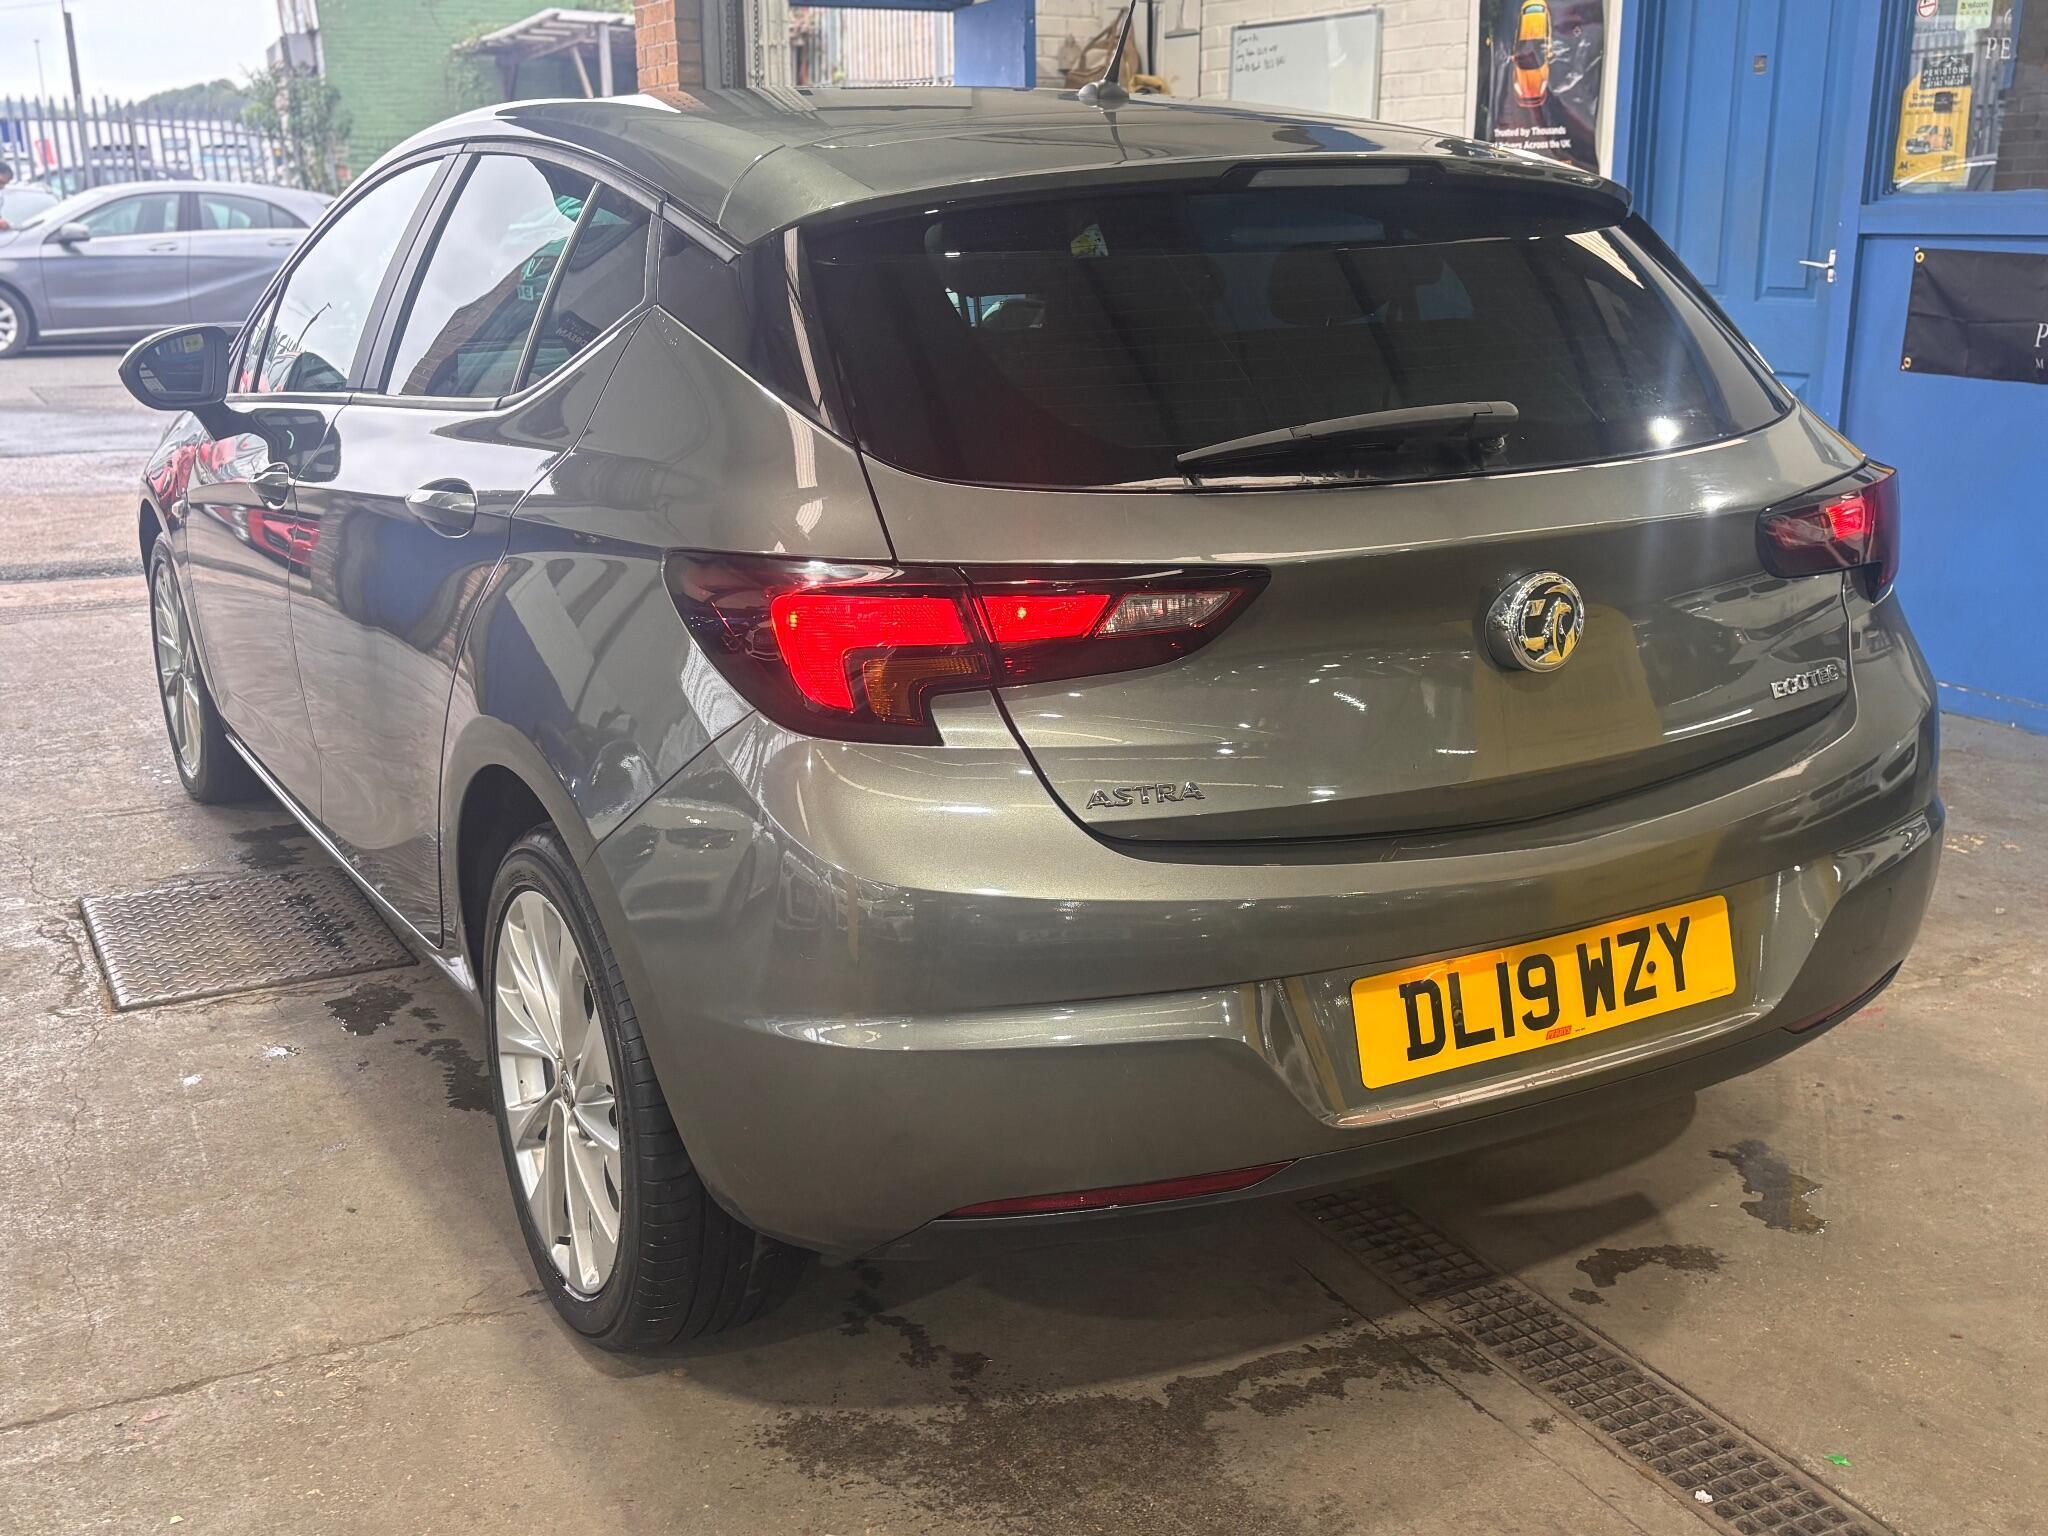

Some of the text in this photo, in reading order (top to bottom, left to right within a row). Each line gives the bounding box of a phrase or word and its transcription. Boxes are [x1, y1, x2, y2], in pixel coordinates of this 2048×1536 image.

[1923, 65, 1969, 76] PENISTONE
[1520, 127, 1530, 137] by
[1531, 126, 1566, 135] Thousands
[1523, 140, 1548, 149] Across
[1549, 140, 1559, 148] the
[1560, 139, 1571, 148] UK
[1770, 664, 1839, 699] ECOTEC
[1086, 781, 1205, 809] ASTRA
[1399, 916, 1690, 1062] DL19 WZY
